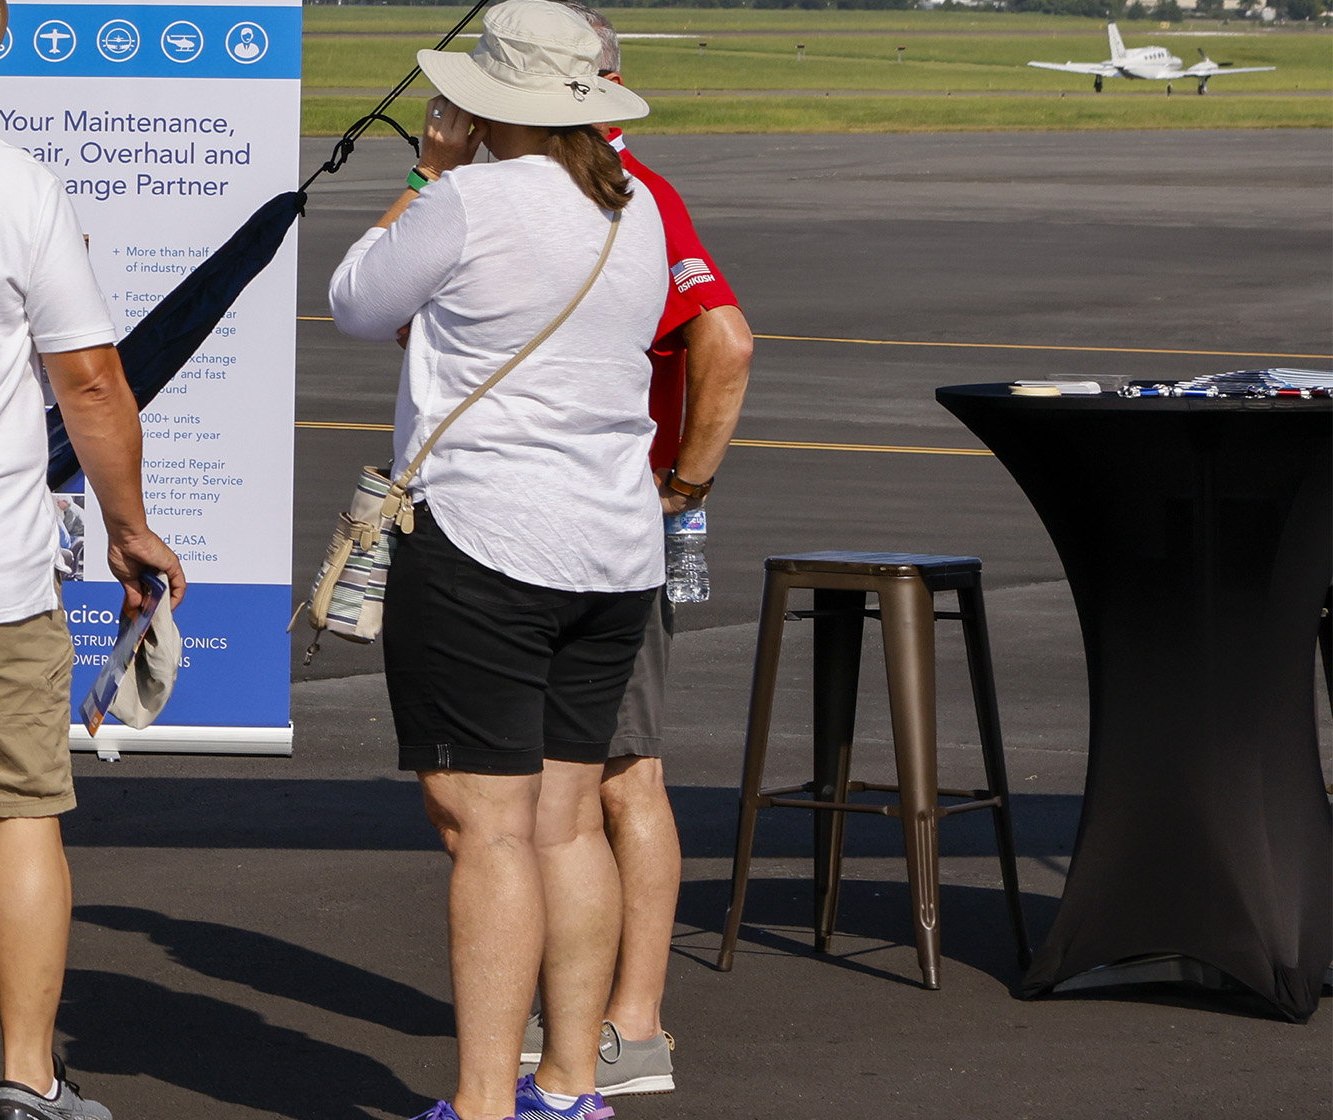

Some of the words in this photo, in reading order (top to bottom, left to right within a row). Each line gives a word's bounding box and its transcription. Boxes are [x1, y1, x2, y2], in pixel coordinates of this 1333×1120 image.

[64, 110, 235, 137] Maintenance,
[80, 141, 195, 164] Overhaul
[204, 142, 251, 165] and
[137, 174, 229, 196] Partner
[126, 246, 157, 257] More
[160, 247, 185, 257] than
[188, 247, 209, 257] half
[126, 262, 138, 272] of
[140, 262, 187, 275] industry
[677, 274, 716, 293] OSHKOSH
[180, 369, 201, 379] and
[205, 368, 226, 379] fast
[174, 414, 201, 424] units
[174, 431, 192, 441] per
[196, 432, 221, 442] year
[189, 459, 225, 472] Repair
[146, 474, 199, 487] Warranty
[202, 474, 243, 486] Service
[170, 489, 186, 500] for
[189, 492, 221, 503] many
[174, 535, 207, 545] EASA
